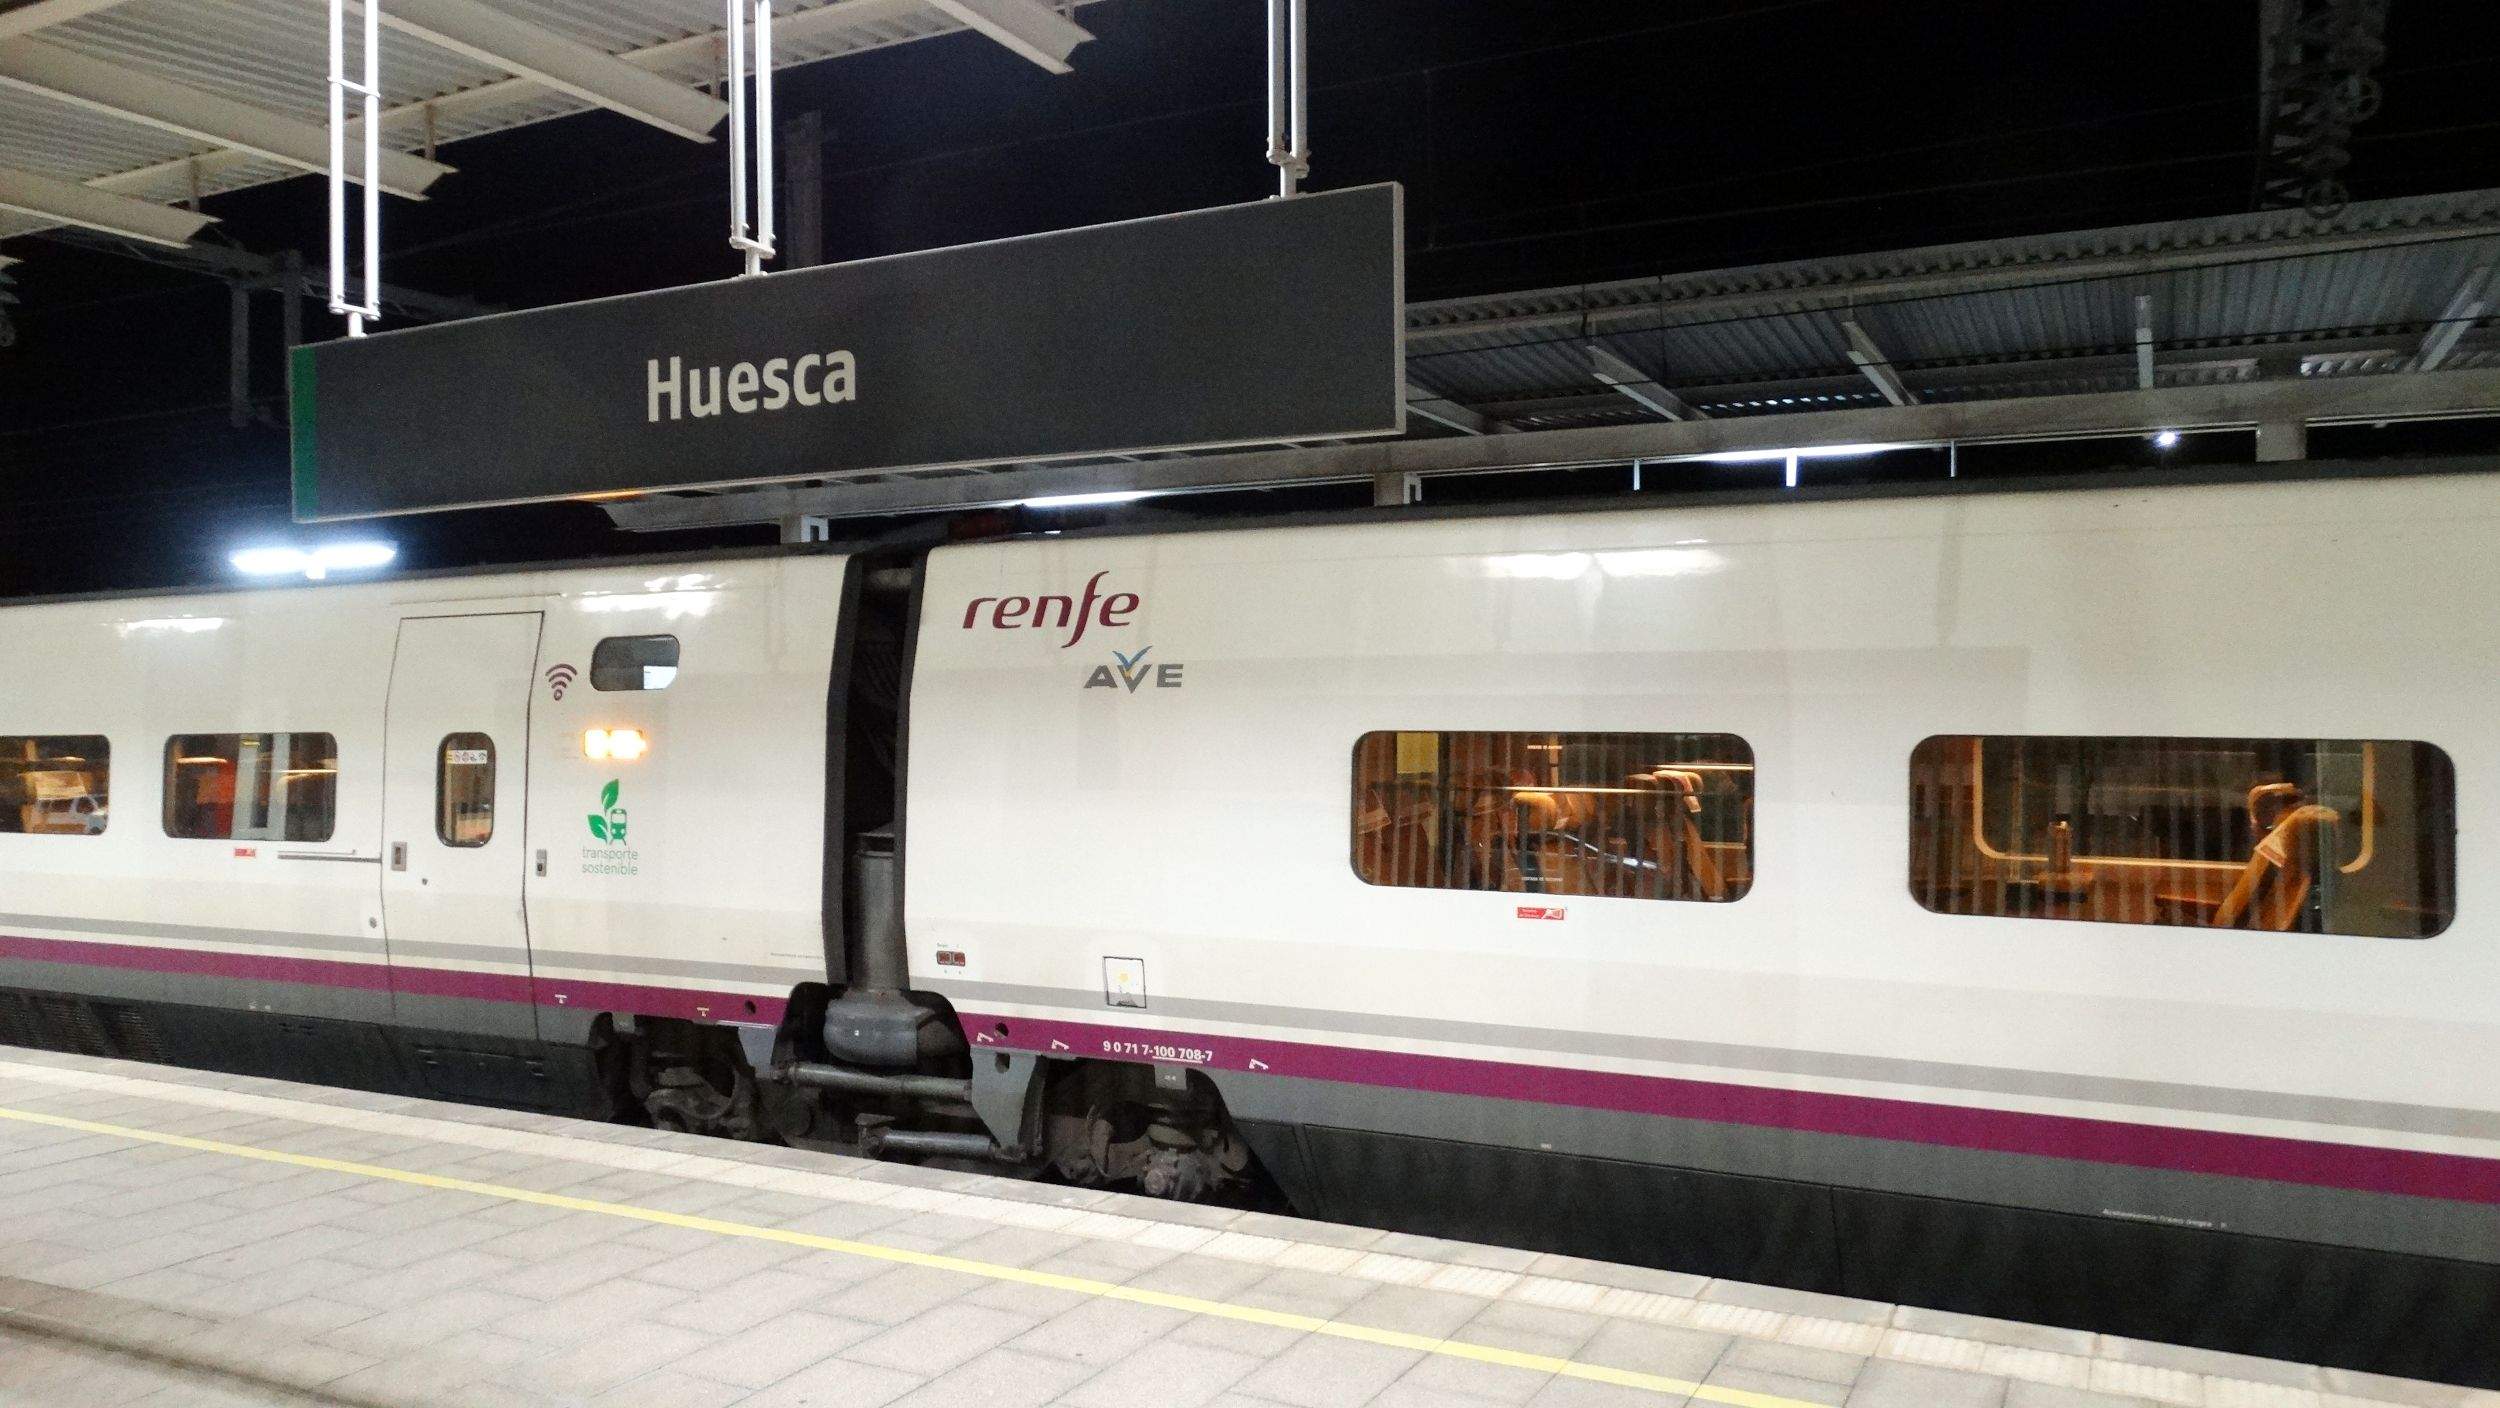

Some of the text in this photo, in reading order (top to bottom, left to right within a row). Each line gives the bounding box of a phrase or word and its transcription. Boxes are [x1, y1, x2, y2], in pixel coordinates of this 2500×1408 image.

[648, 350, 856, 422] Huesca
[962, 570, 1140, 648] renfe
[1083, 645, 1184, 694] AVE
[582, 846, 638, 861] transporte
[582, 863, 638, 875] sostenible
[1124, 1043, 1138, 1054] 71
[1178, 1048, 1213, 1061] 708-7
